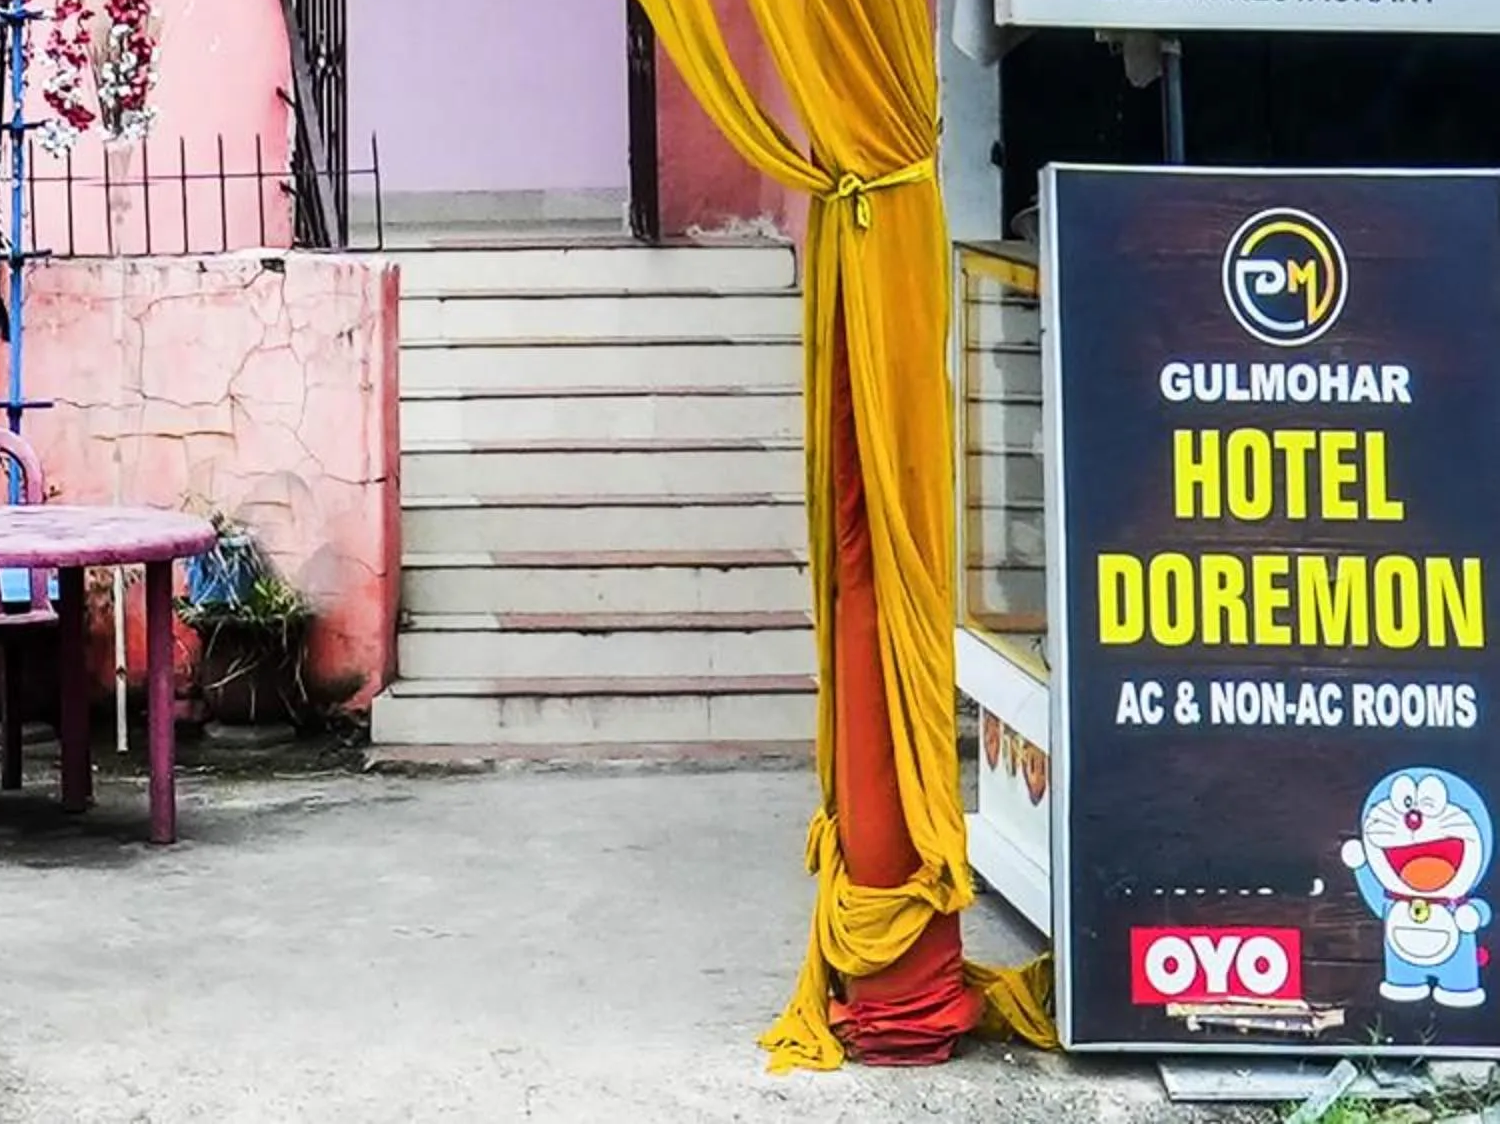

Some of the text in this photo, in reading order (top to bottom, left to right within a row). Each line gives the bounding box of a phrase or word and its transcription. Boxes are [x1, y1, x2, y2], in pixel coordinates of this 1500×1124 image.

[1160, 363, 1412, 403] GULMOHAR
[1173, 428, 1405, 521] HOTEL
[1098, 553, 1485, 648] DOREMON
[1116, 681, 1478, 728] AC & NON-AC ROOMS
[1144, 934, 1290, 996] OYO
